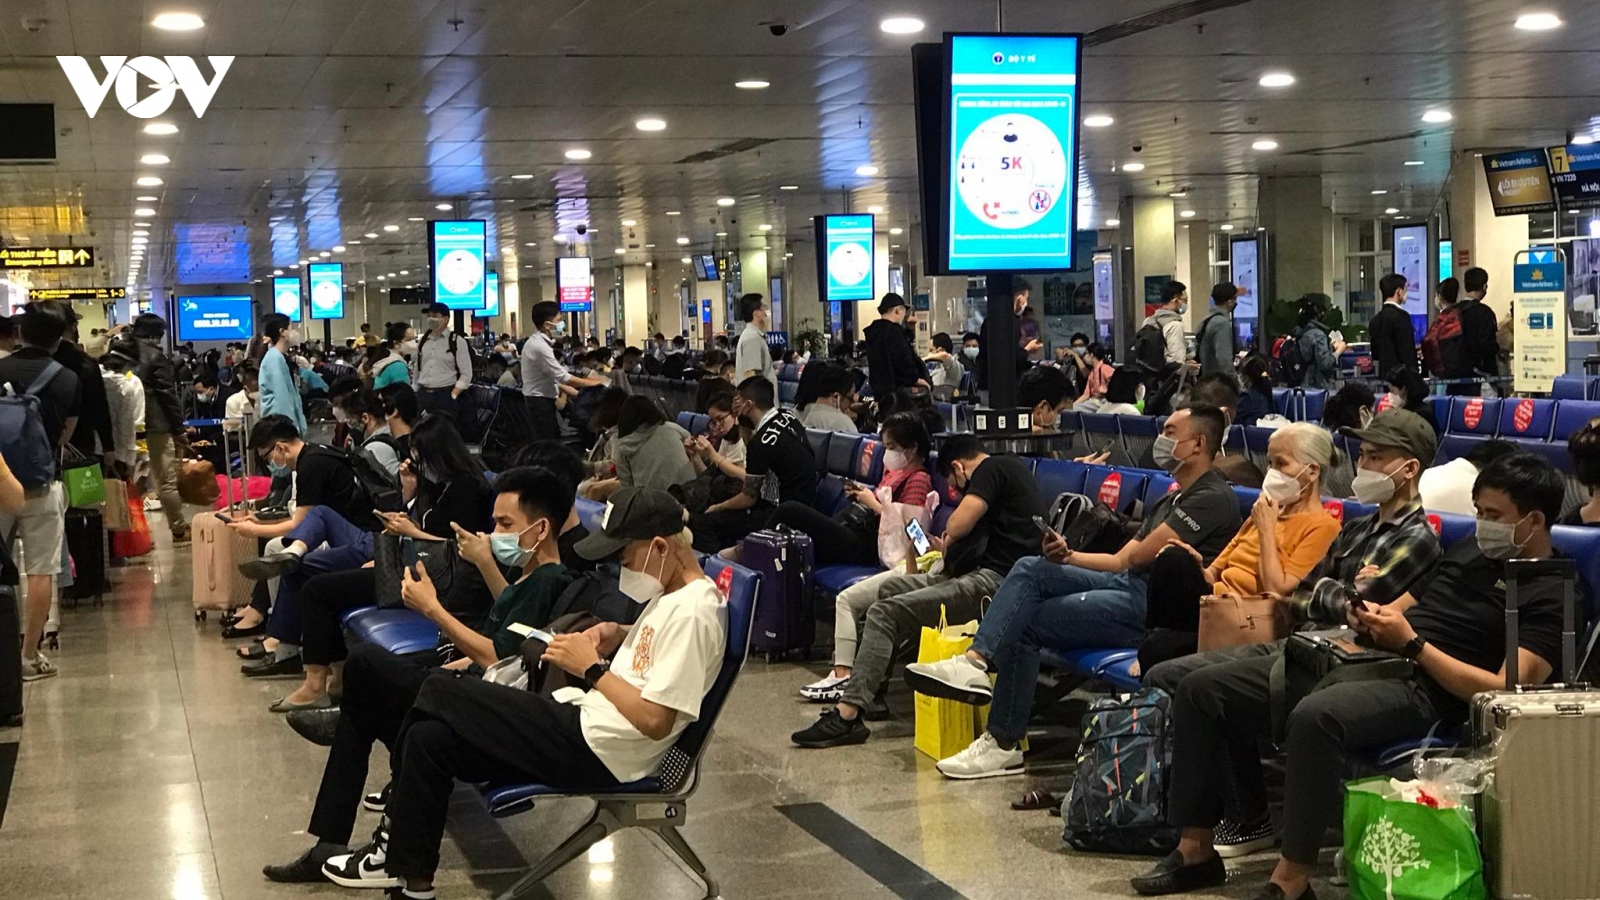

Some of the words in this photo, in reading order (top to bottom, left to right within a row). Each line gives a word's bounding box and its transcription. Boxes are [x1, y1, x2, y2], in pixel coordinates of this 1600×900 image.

[1001, 156, 1022, 170] 5K
[1555, 157, 1563, 171] 7
[1564, 174, 1577, 182] 7220
[110, 289, 125, 297] 1-3
[1183, 516, 1201, 532] PRO
